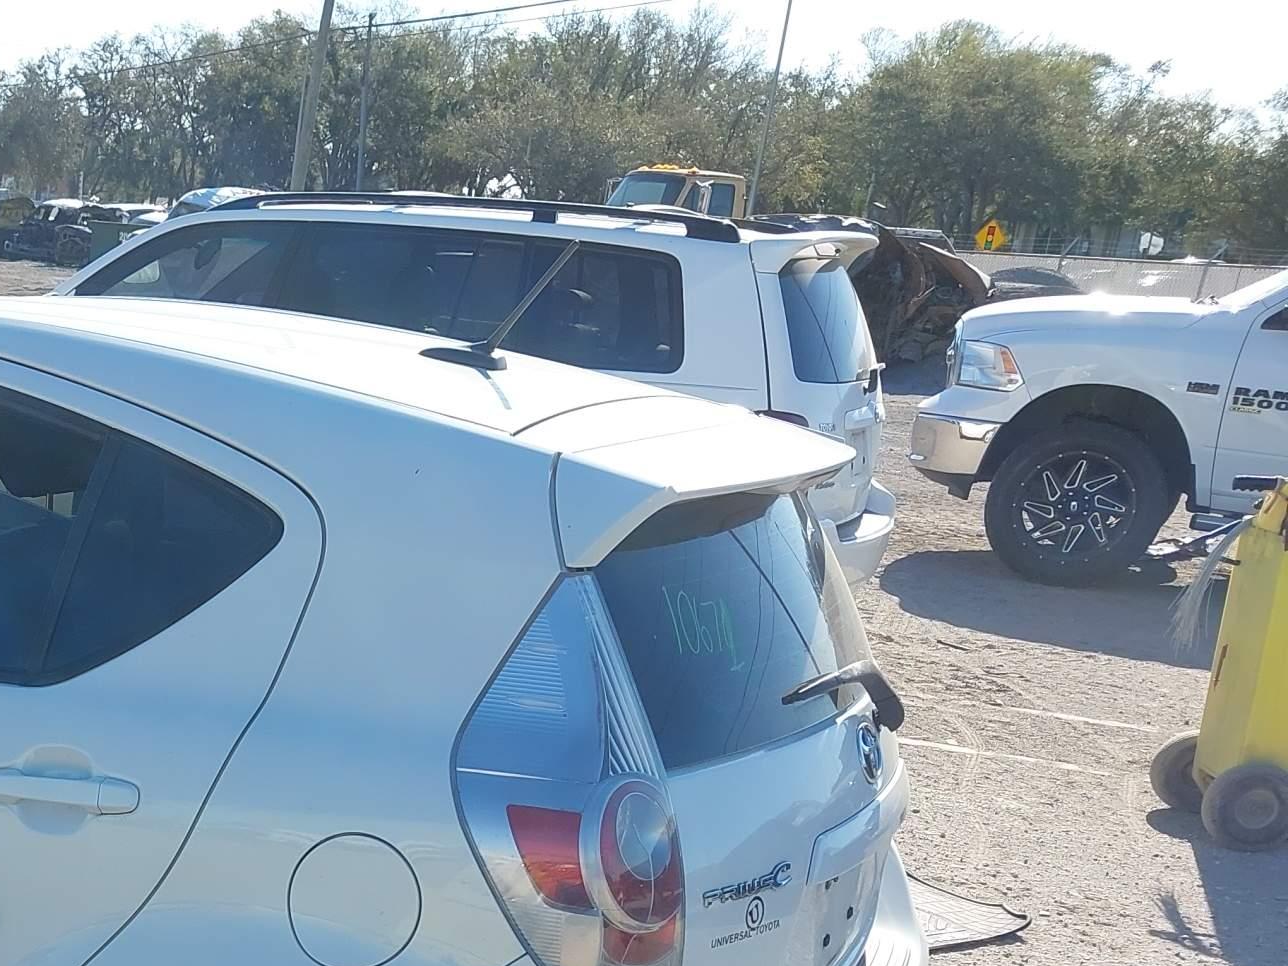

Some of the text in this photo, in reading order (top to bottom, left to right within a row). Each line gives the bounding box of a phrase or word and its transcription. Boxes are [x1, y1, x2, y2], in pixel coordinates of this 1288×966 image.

[1234, 387, 1288, 401] RAM
[711, 919, 780, 948] UNIVERSAL TOYOTA
